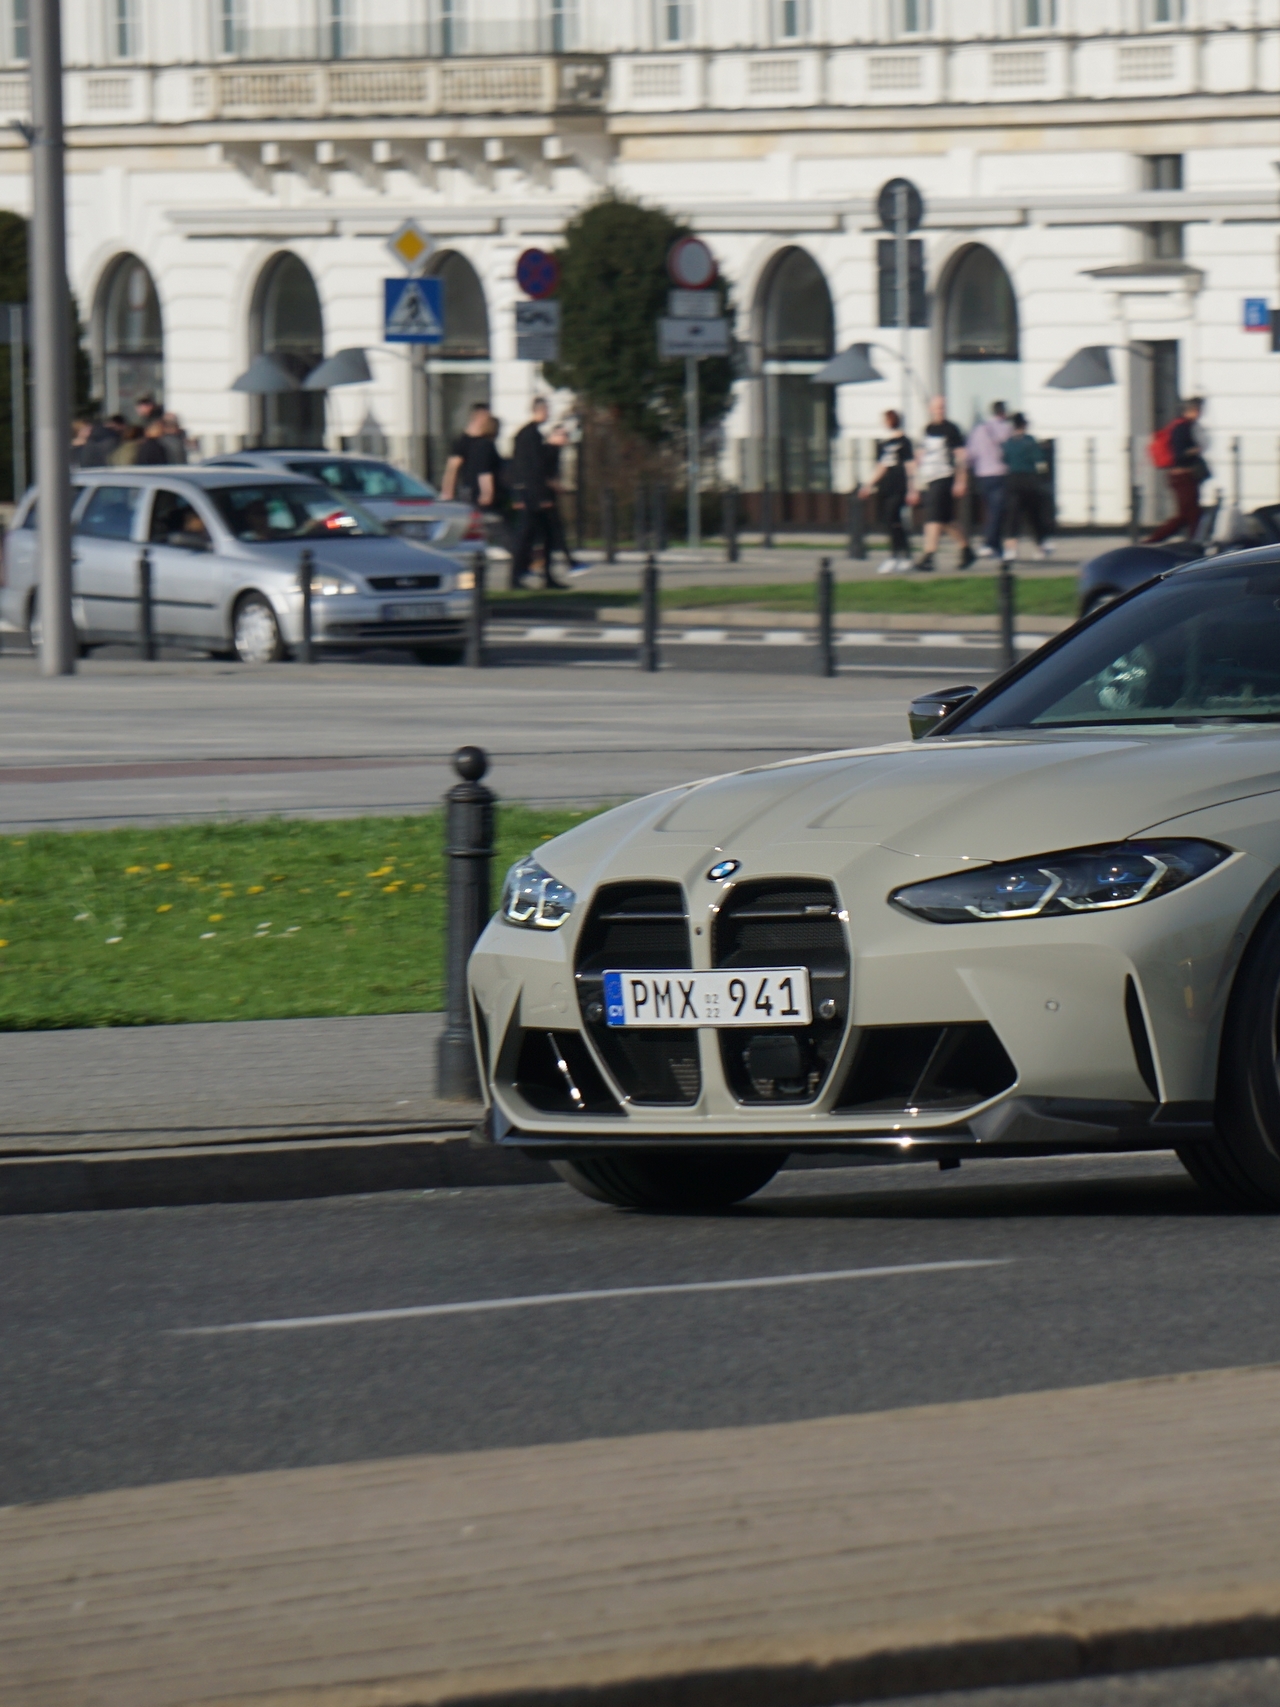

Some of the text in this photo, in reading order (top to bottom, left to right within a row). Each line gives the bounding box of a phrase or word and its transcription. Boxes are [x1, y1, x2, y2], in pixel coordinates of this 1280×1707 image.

[630, 977, 799, 1018] PMX 941
[705, 1007, 720, 1018] 22
